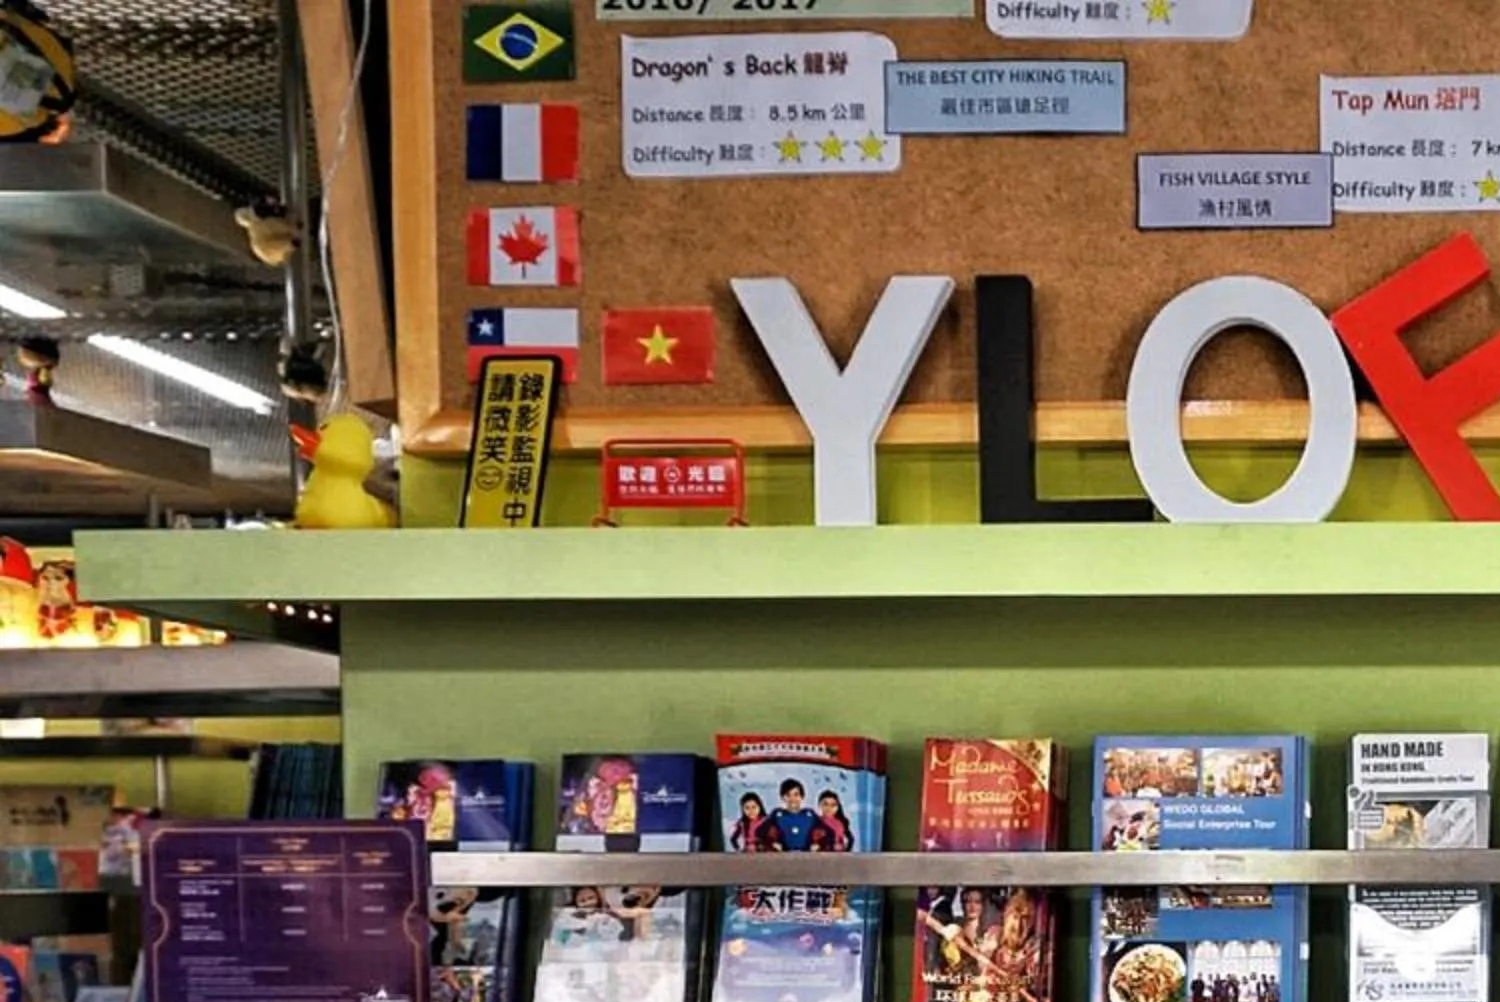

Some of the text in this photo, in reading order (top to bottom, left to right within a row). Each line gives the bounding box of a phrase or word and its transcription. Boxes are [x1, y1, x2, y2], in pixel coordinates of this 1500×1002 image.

[998, 2, 1079, 22] Difficulty
[745, 54, 797, 75] Back
[897, 69, 1114, 85] THE BEST CITY HIKING TRAIL
[1383, 90, 1429, 110] Mun
[632, 106, 703, 123] Distance
[769, 106, 798, 121] 8.5
[802, 104, 826, 121] km
[832, 104, 865, 121] 公里
[632, 146, 713, 165] Difficulty
[1333, 141, 1406, 158] Distance
[1471, 142, 1481, 157] 7
[1160, 171, 1311, 187] FISH VILLAGE STYLE
[1332, 181, 1414, 200] Difficulty
[1199, 199, 1272, 218] 漁村風情
[1361, 742, 1444, 758] HAND MADE
